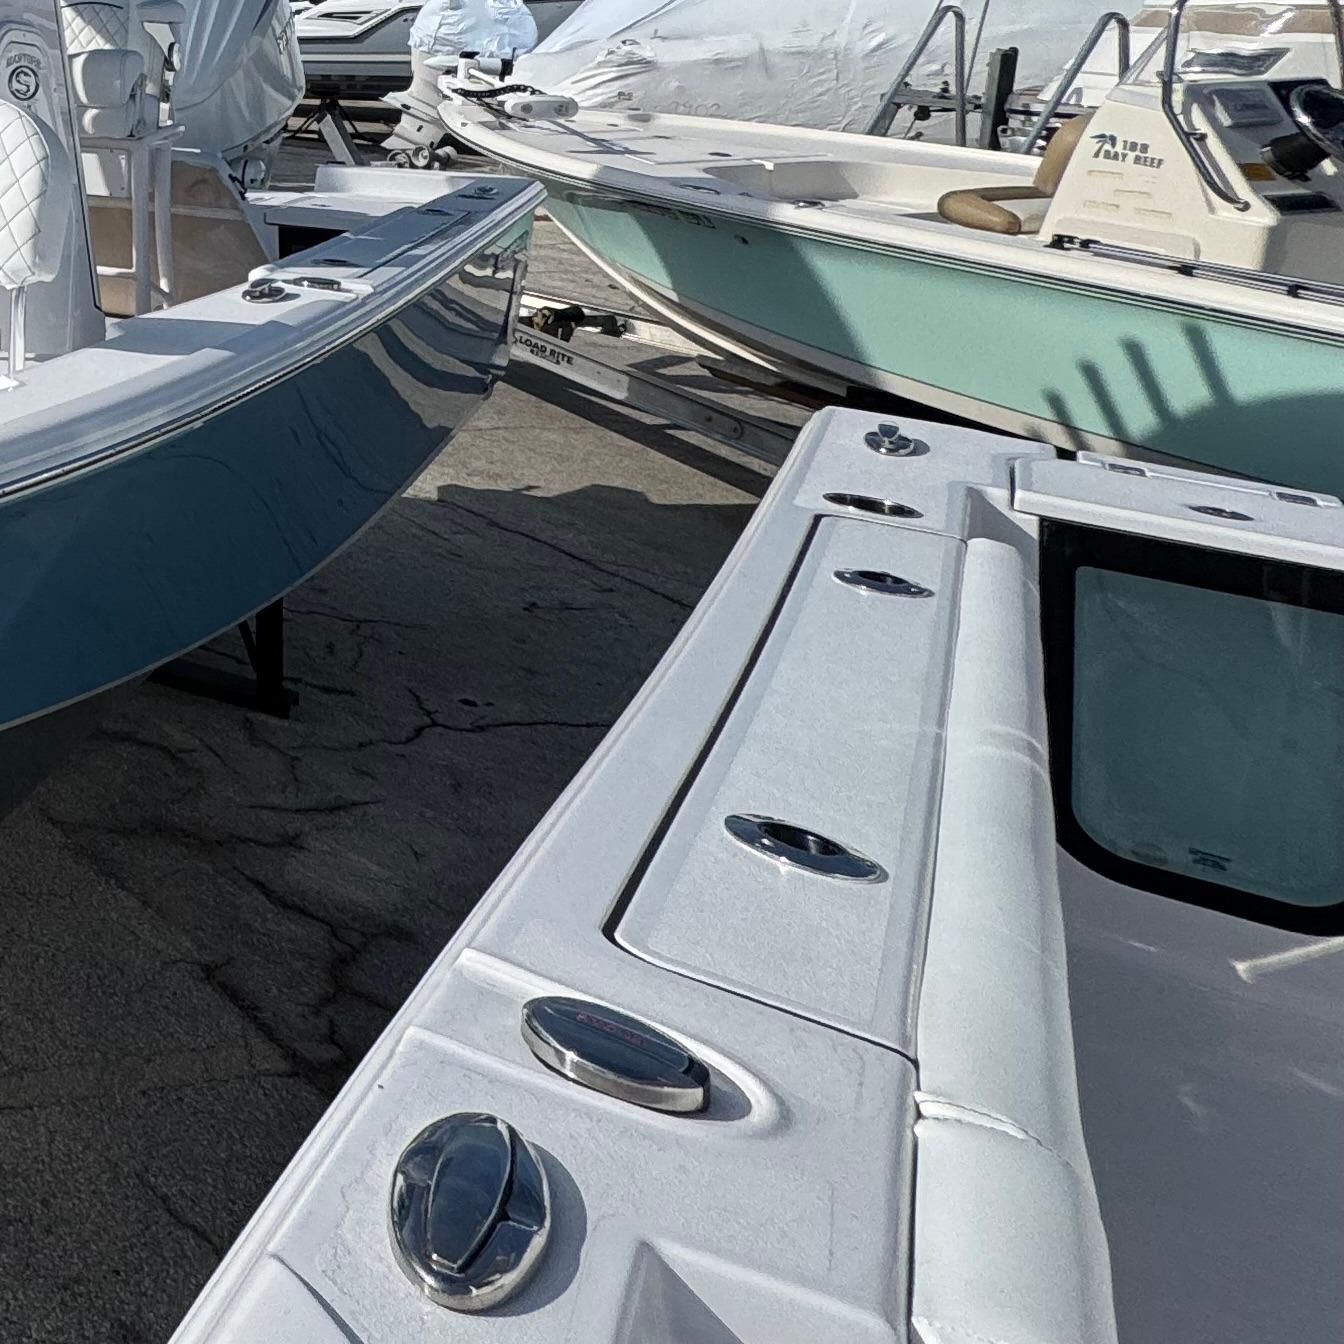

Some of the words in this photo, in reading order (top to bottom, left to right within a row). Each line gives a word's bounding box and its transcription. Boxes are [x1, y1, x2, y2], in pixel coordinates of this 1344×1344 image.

[1133, 154, 1165, 169] REEF
[519, 335, 548, 354] LOAD
[549, 349, 575, 366] RITE
